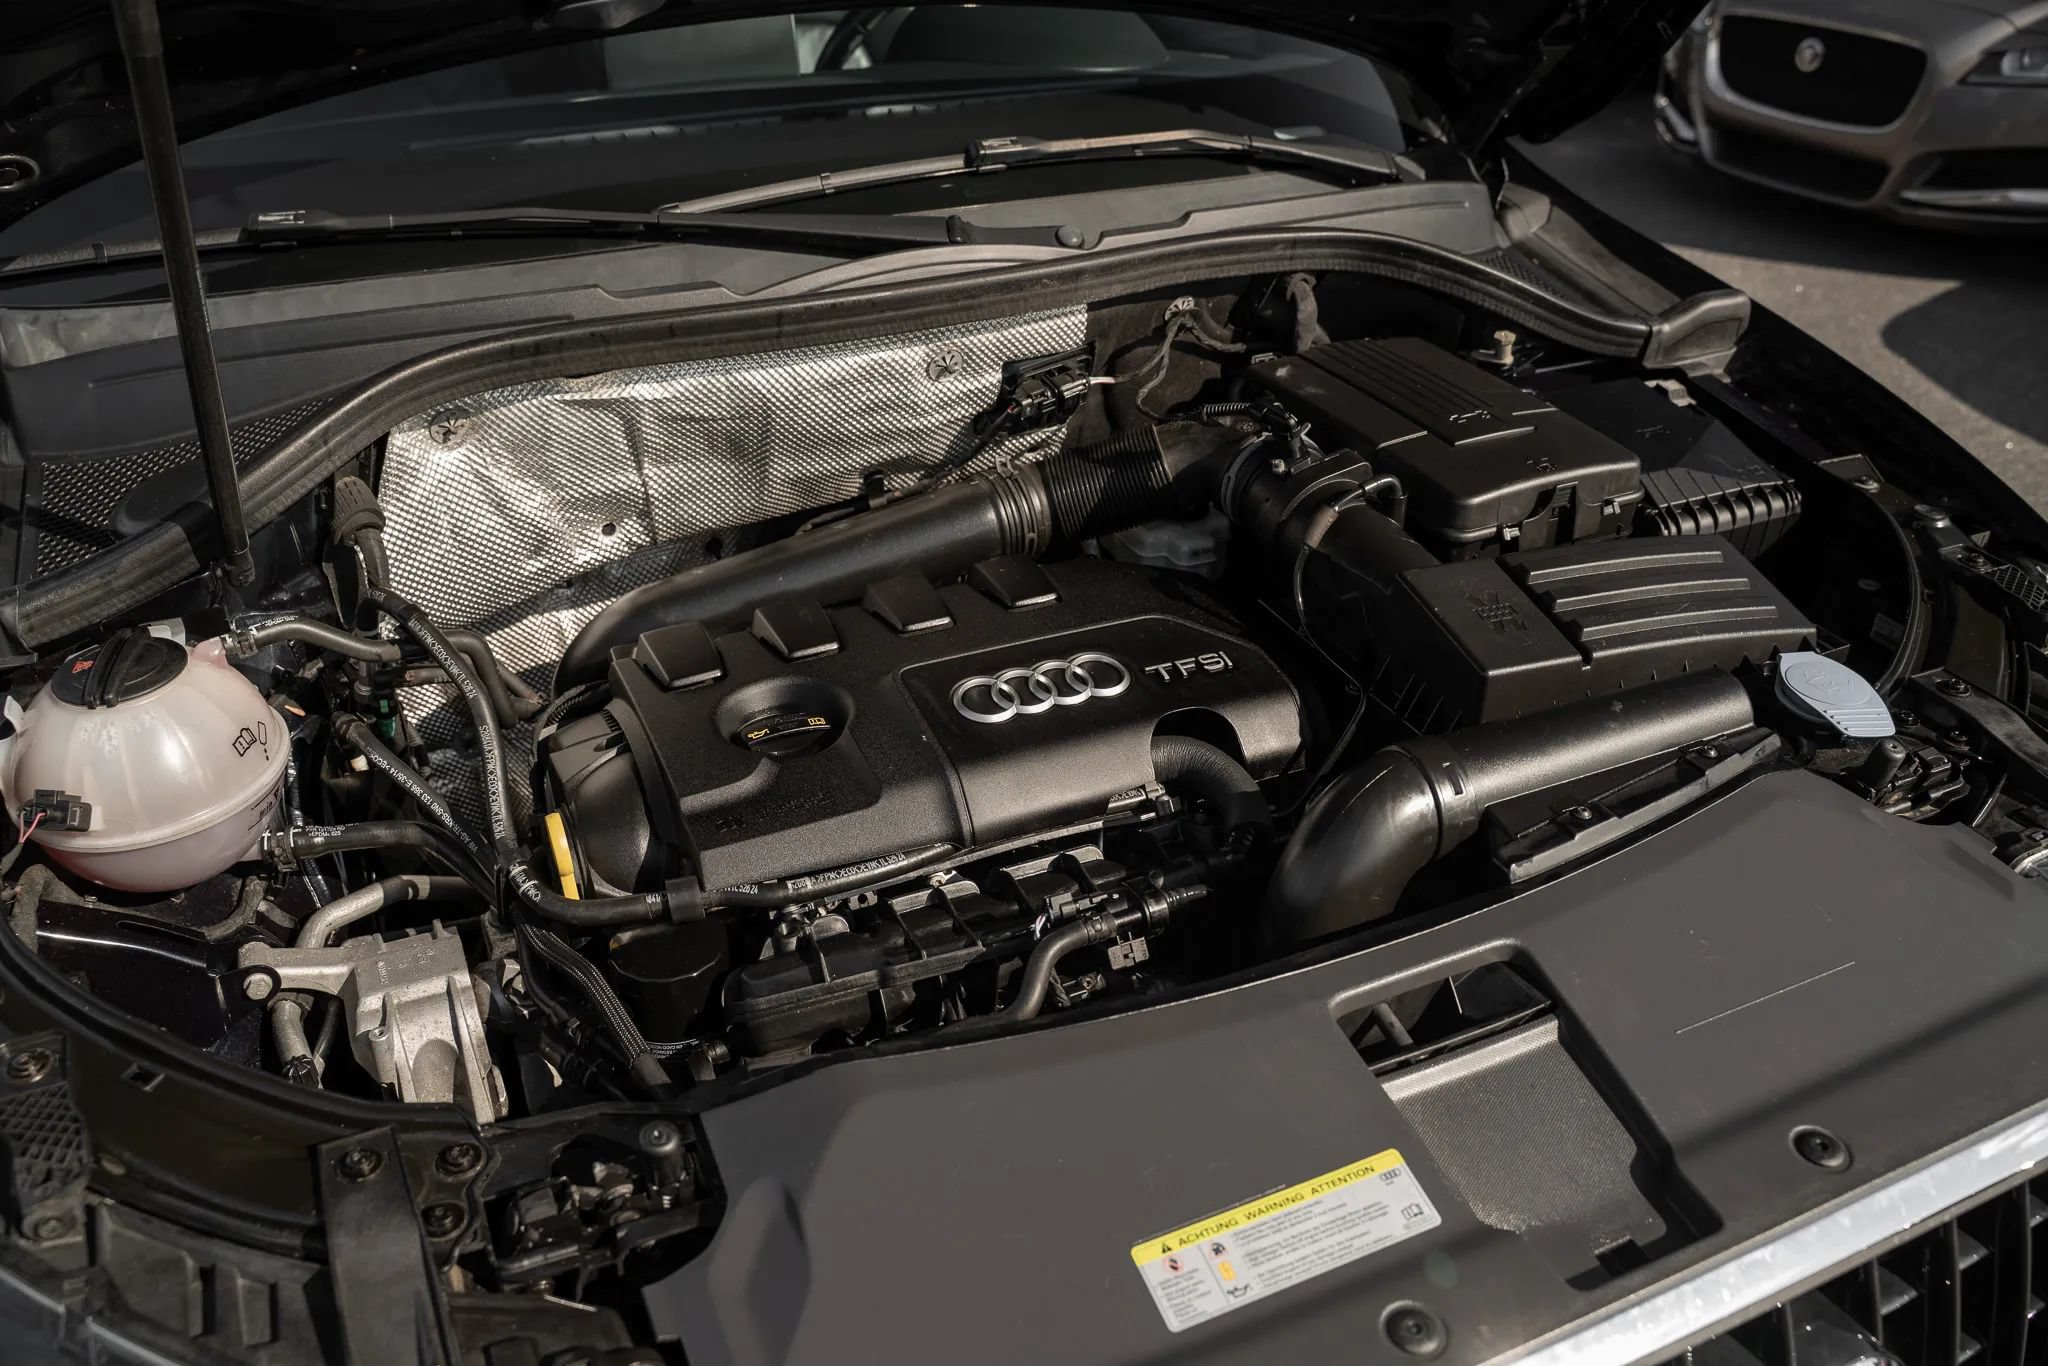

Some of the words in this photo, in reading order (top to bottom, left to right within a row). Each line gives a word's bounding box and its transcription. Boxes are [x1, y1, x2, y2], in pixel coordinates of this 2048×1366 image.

[1145, 651, 1233, 682] TFSI
[369, 751, 389, 771] >ECO<
[389, 765, 412, 788] E-35/14
[409, 783, 423, 796] 366
[420, 792, 433, 805] 133
[1178, 1218, 1239, 1247] ACHTUNG
[1243, 1192, 1305, 1221] WARNING
[1310, 1164, 1375, 1196] ATTENTION
